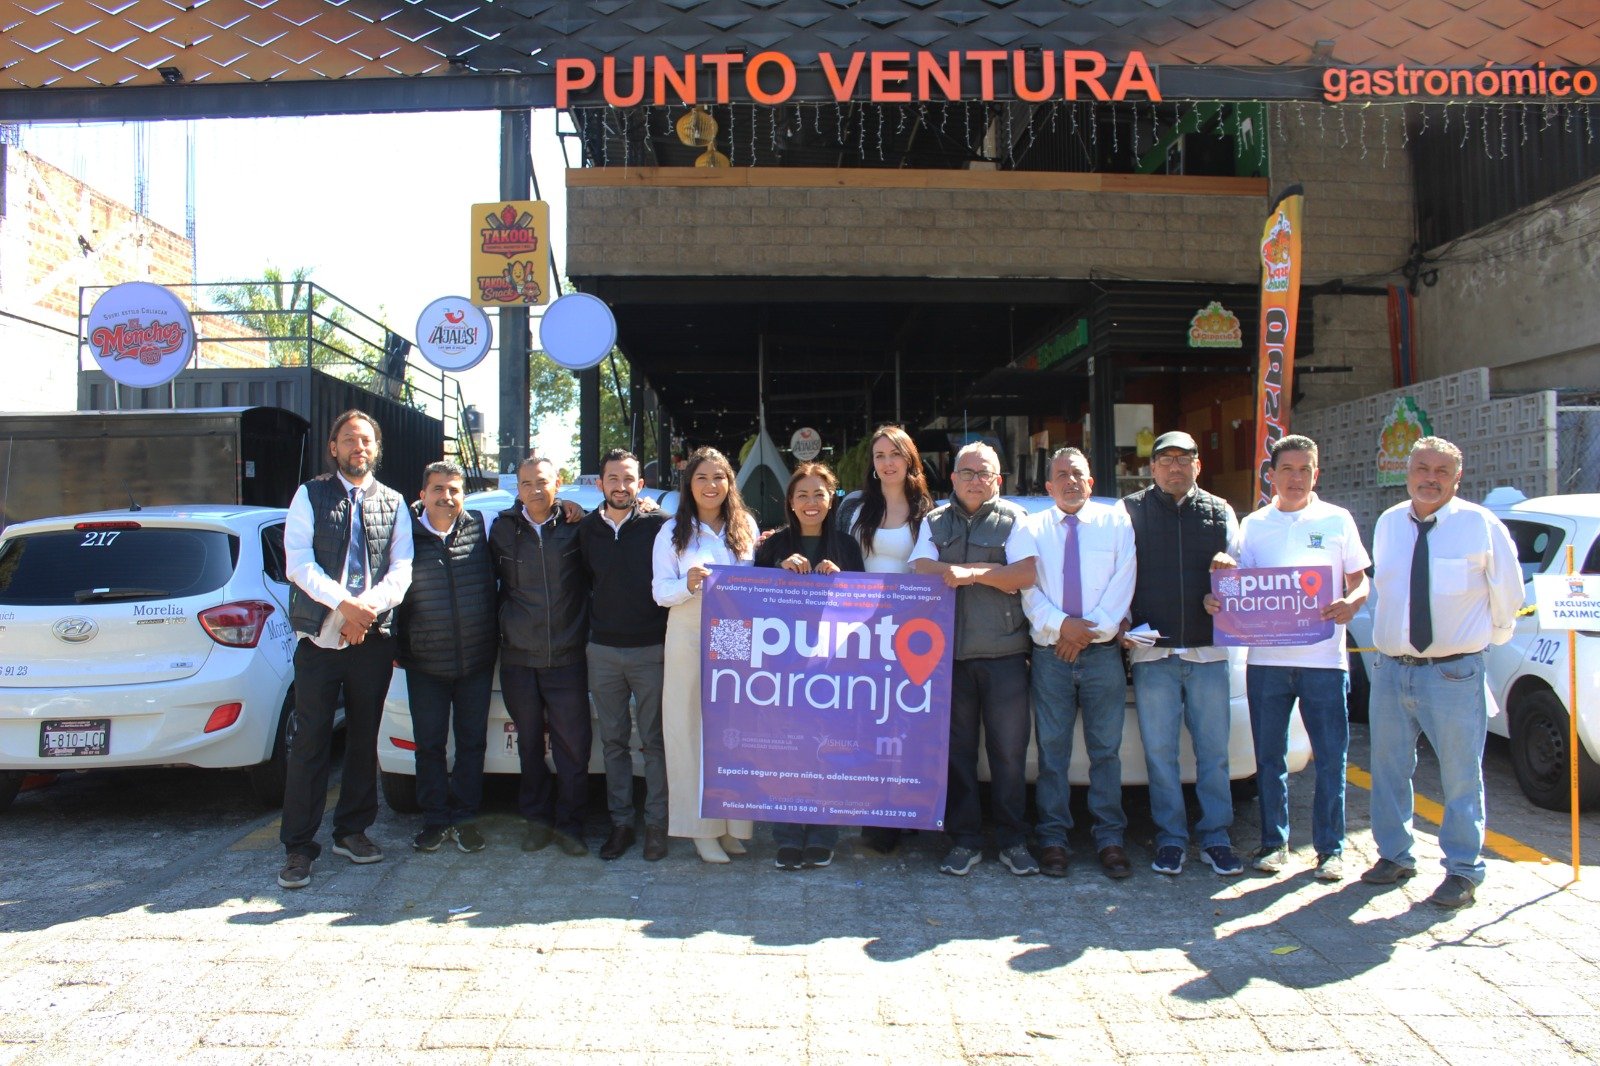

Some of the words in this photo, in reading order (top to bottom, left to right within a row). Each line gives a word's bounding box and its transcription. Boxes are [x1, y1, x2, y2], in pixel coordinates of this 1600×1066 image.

[555, 51, 798, 108] PUNTO
[818, 49, 1163, 103] VENTURA
[1322, 59, 1598, 103] gastronómico
[482, 229, 536, 243] TAKOOL
[80, 531, 121, 547] 217
[716, 584, 748, 592] ayudarte
[753, 586, 783, 594] haremos
[809, 589, 834, 597] posible
[835, 591, 851, 599] para
[867, 590, 885, 598] estés
[892, 592, 916, 601] llegues
[900, 584, 931, 592] Podemos
[769, 596, 776, 604] tu
[777, 597, 804, 605] destino.
[805, 599, 840, 607] Recuerda,
[1225, 590, 1319, 615] naranja
[133, 604, 184, 616] Morelia
[1552, 610, 1600, 619] TAXIMIC
[1530, 637, 1561, 666] 202
[5, 666, 16, 676] 91
[17, 666, 28, 676] 23
[710, 664, 932, 725] naranja
[717, 766, 749, 776] Espacio
[750, 769, 778, 778] seguro
[779, 771, 799, 779] para
[800, 771, 825, 780] niñas,
[826, 773, 879, 782] adolescentes
[886, 776, 921, 785] mujeres.
[829, 807, 870, 816] Semmujeris:
